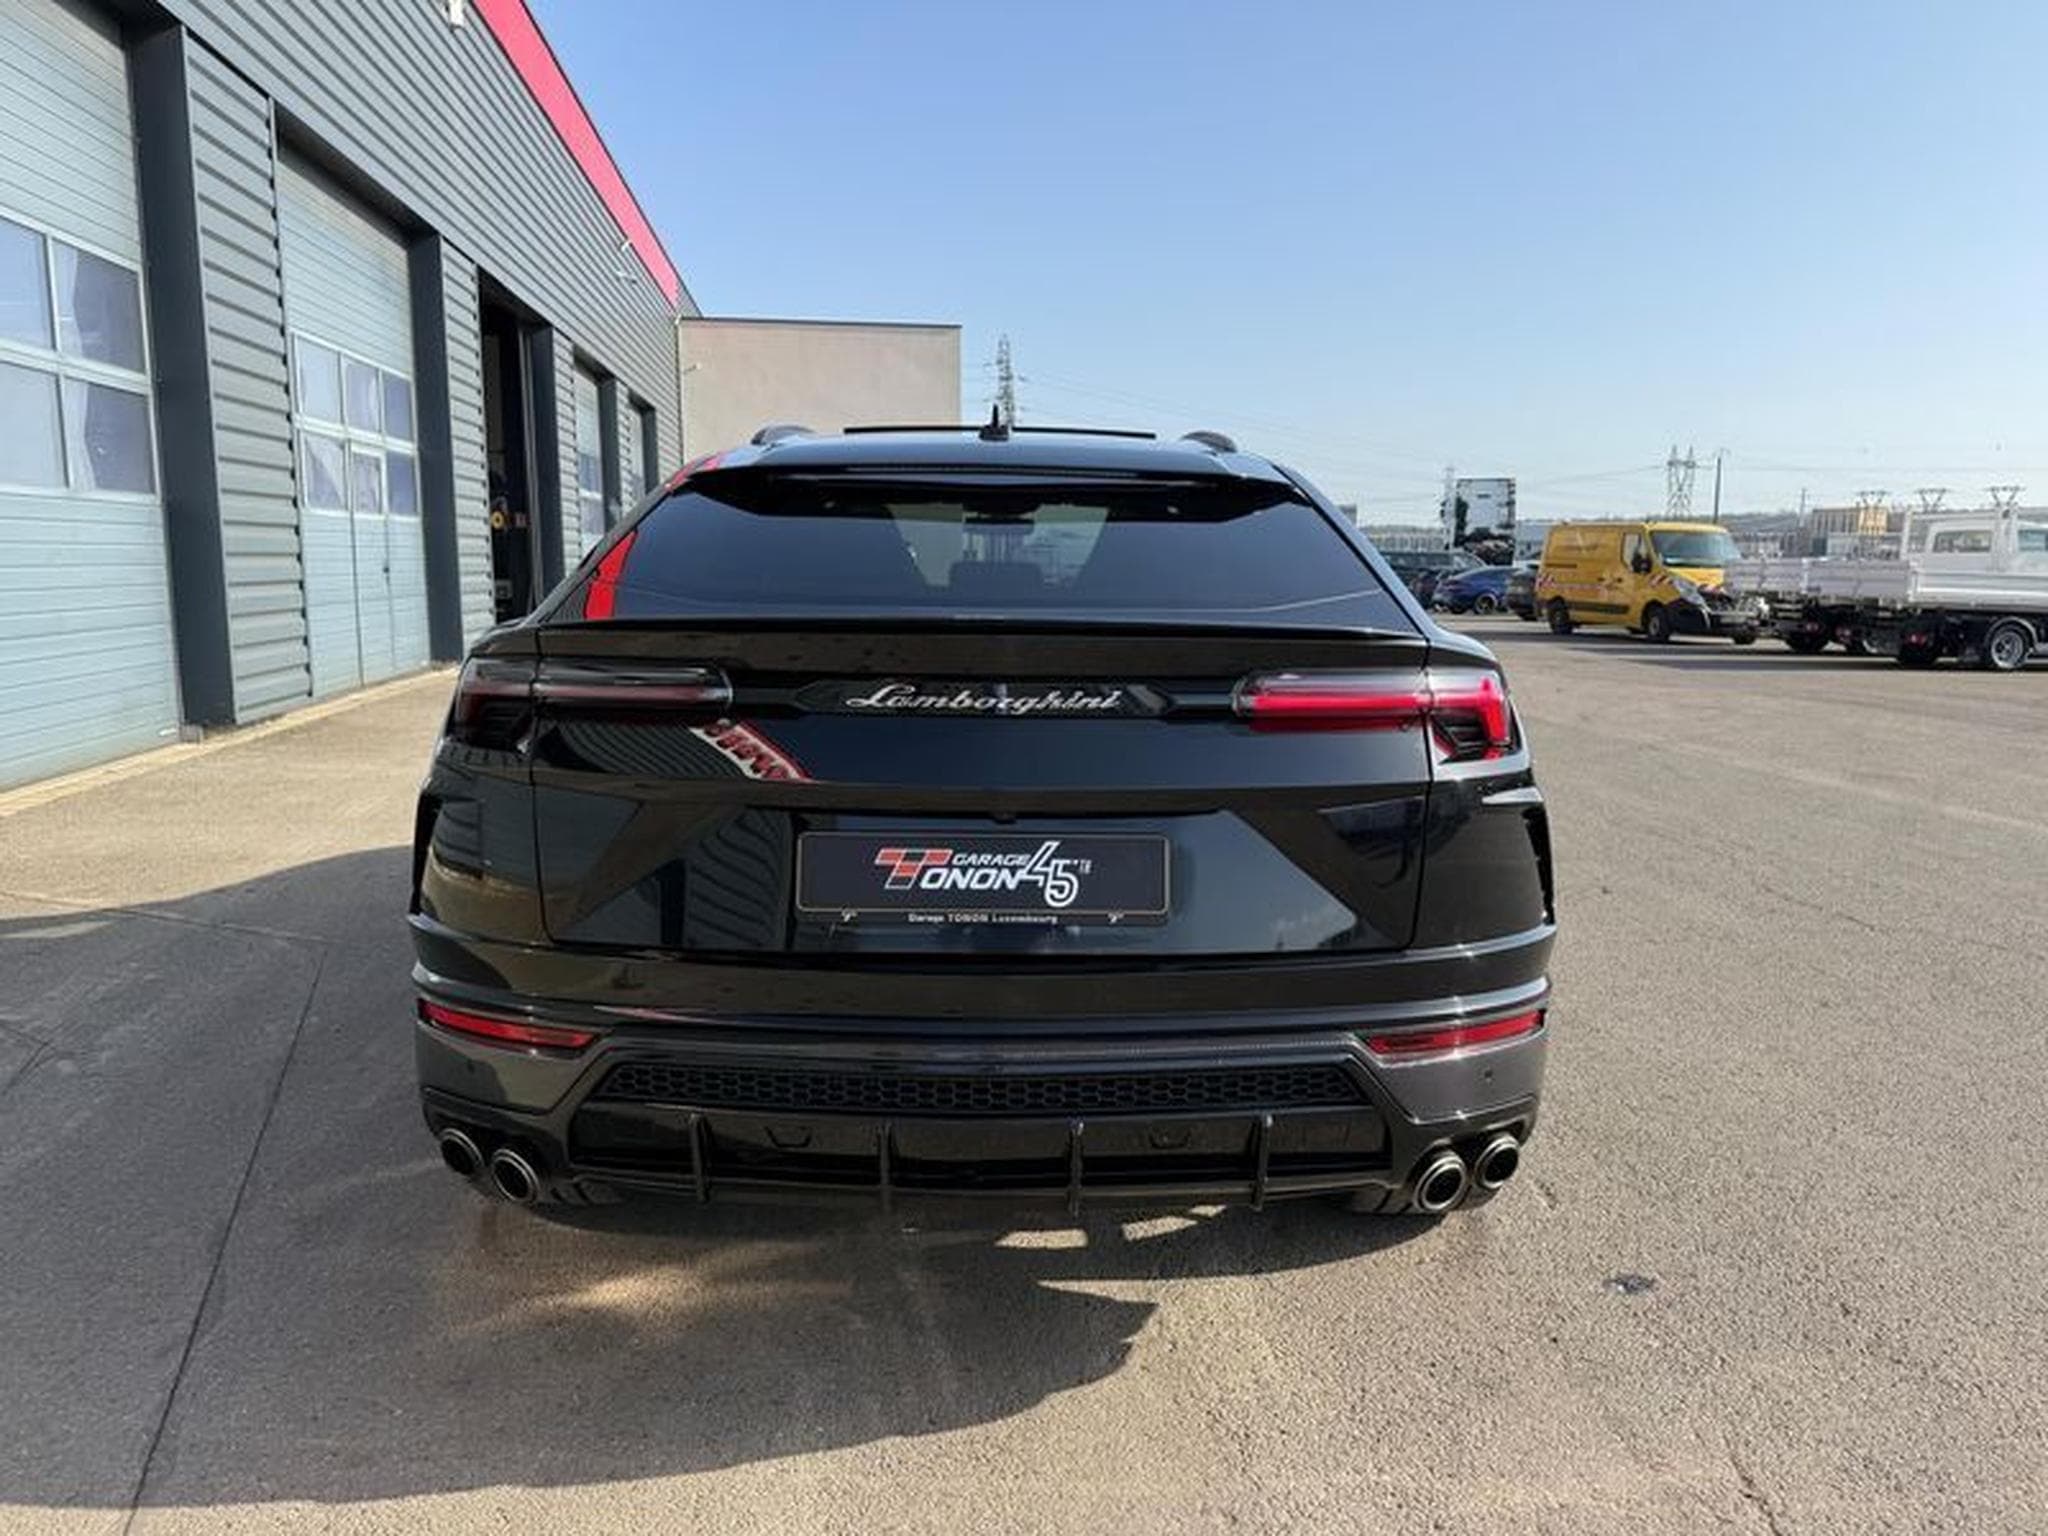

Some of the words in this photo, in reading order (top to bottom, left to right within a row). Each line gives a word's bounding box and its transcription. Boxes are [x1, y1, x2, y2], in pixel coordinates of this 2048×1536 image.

[846, 682, 1123, 714] Lamborghini
[951, 854, 1030, 866] GARAGE
[908, 913, 944, 923] Garage
